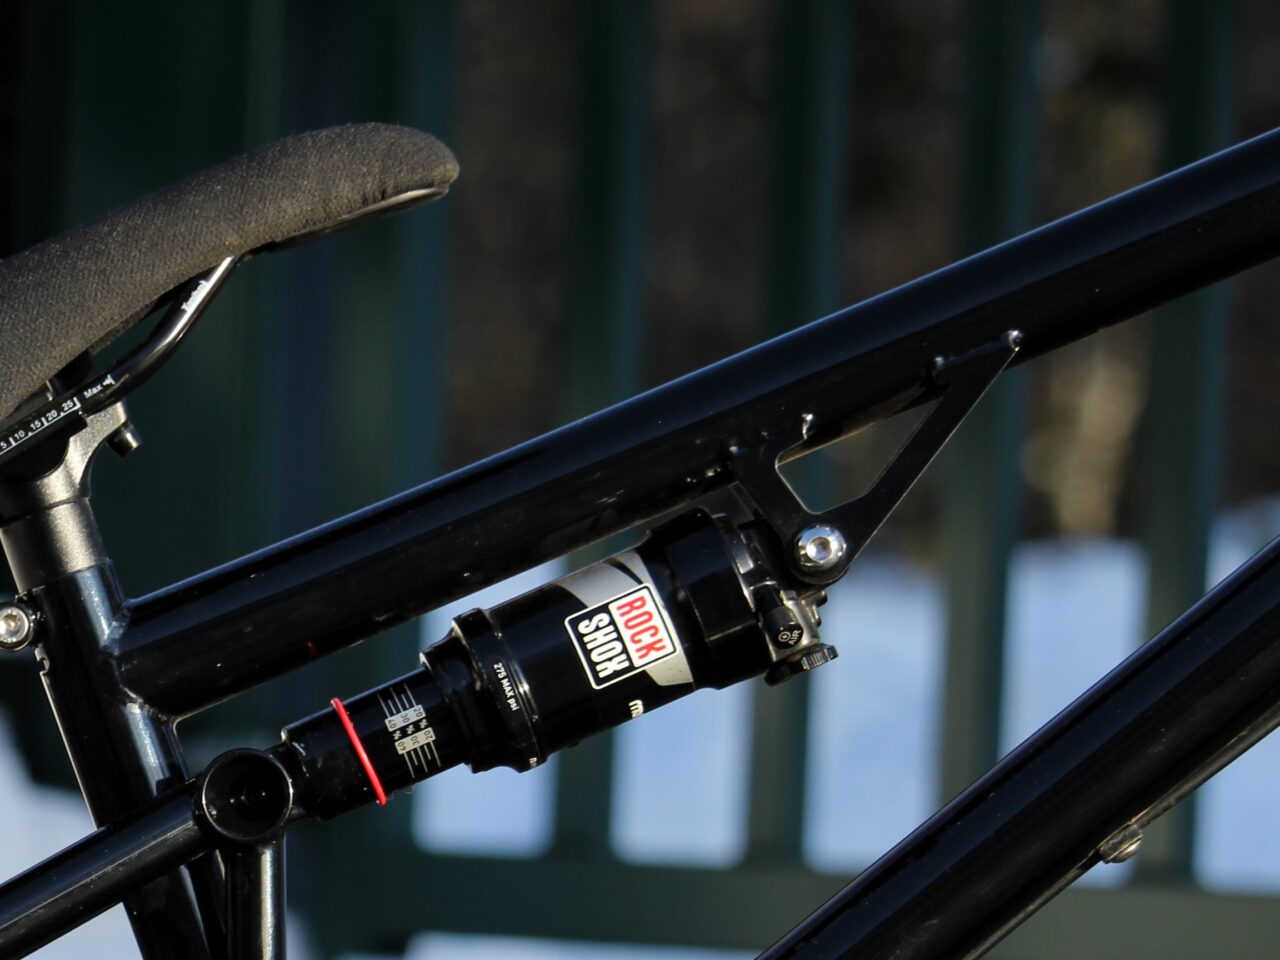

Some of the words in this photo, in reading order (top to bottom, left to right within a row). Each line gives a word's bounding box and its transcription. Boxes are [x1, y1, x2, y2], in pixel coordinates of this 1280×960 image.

[0, 441, 8, 450] 5
[14, 430, 25, 441] 10
[30, 420, 42, 431] 15
[46, 410, 58, 421] 20
[61, 401, 73, 412] 25
[83, 384, 103, 399] Max
[616, 595, 667, 660] ROCK
[577, 612, 630, 678] SHOX
[787, 630, 802, 646] AIR
[493, 662, 507, 679] 275
[500, 678, 515, 698] MAX
[506, 698, 520, 711] psi
[400, 713, 410, 723] 30
[414, 706, 424, 718] 20
[387, 719, 397, 729] 40
[410, 736, 420, 746] 30
[423, 730, 433, 740] 20
